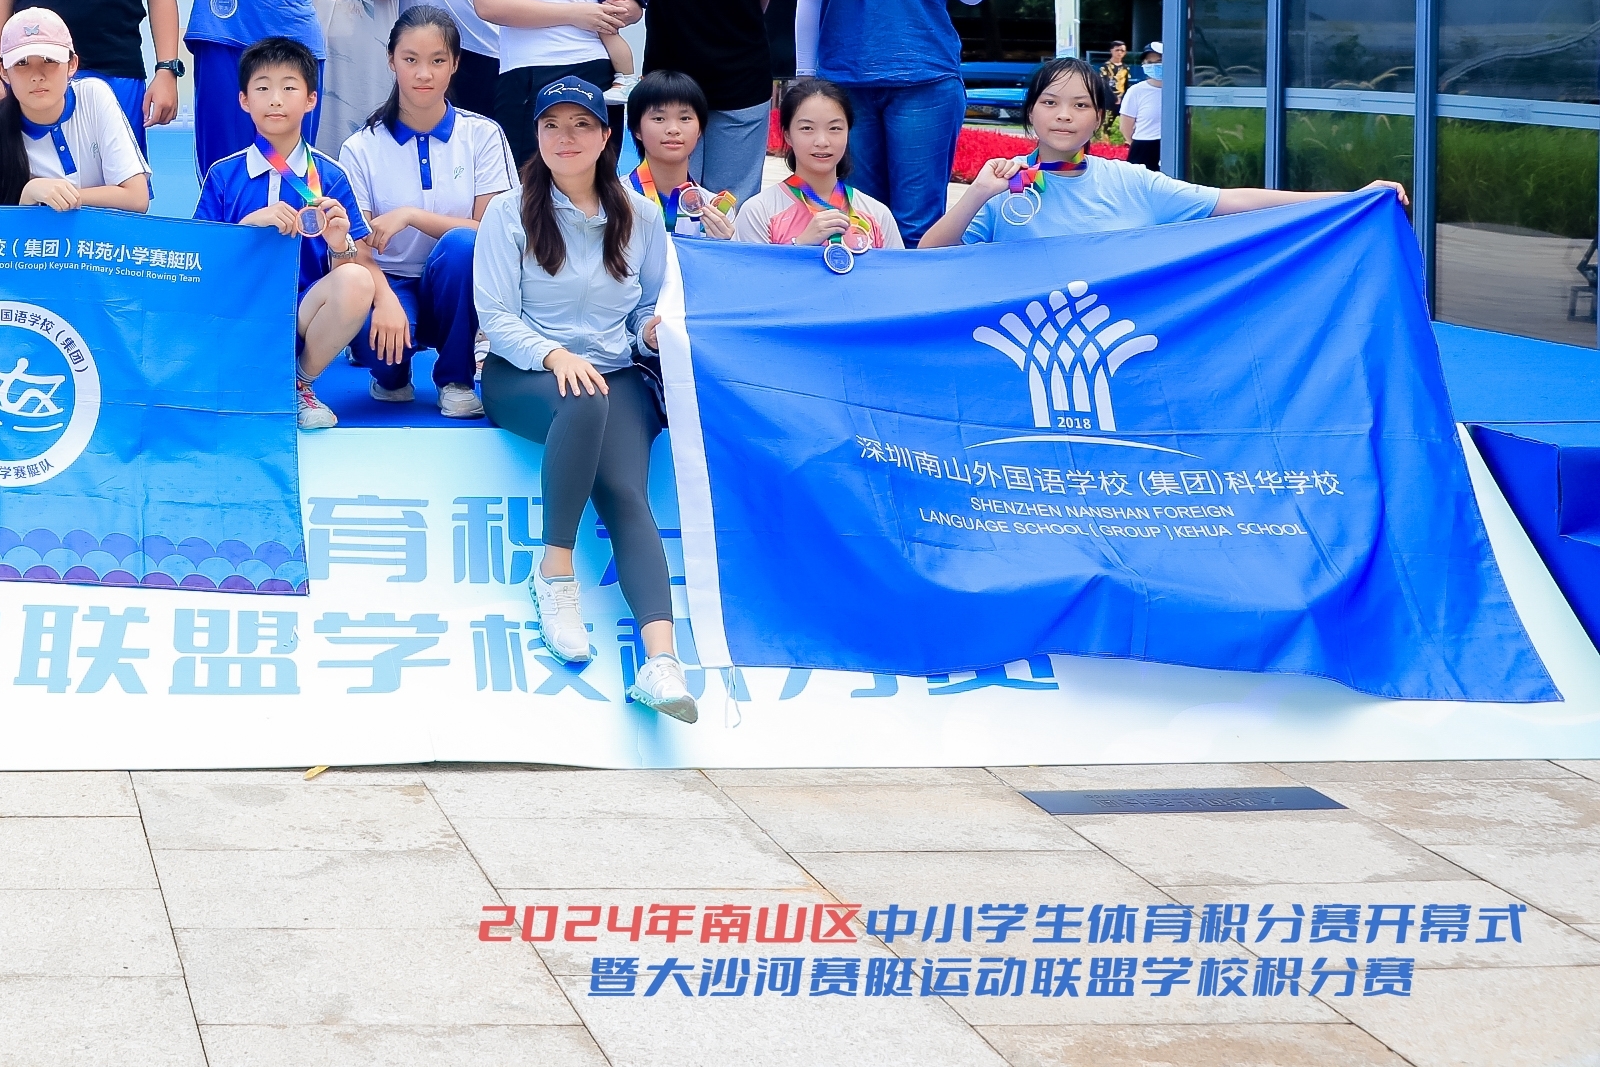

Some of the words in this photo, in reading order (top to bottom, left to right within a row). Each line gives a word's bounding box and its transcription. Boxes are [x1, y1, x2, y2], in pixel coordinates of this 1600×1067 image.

[14, 261, 47, 272] (Group)
[48, 261, 79, 272] Keyuan
[80, 262, 114, 275] Primary
[115, 266, 145, 278] School
[146, 270, 177, 283] Rowing
[178, 273, 201, 283] Team
[1056, 416, 1092, 430] 2018
[969, 496, 1063, 518] SHENZHEN
[1064, 504, 1151, 521] NANSHAN
[1152, 504, 1236, 520] FOREIGN
[918, 507, 1012, 534] LANGUAGE
[1014, 522, 1090, 536] SCHOOL
[1174, 524, 1233, 539] KEHUA
[1236, 522, 1309, 537] SCHOOL
